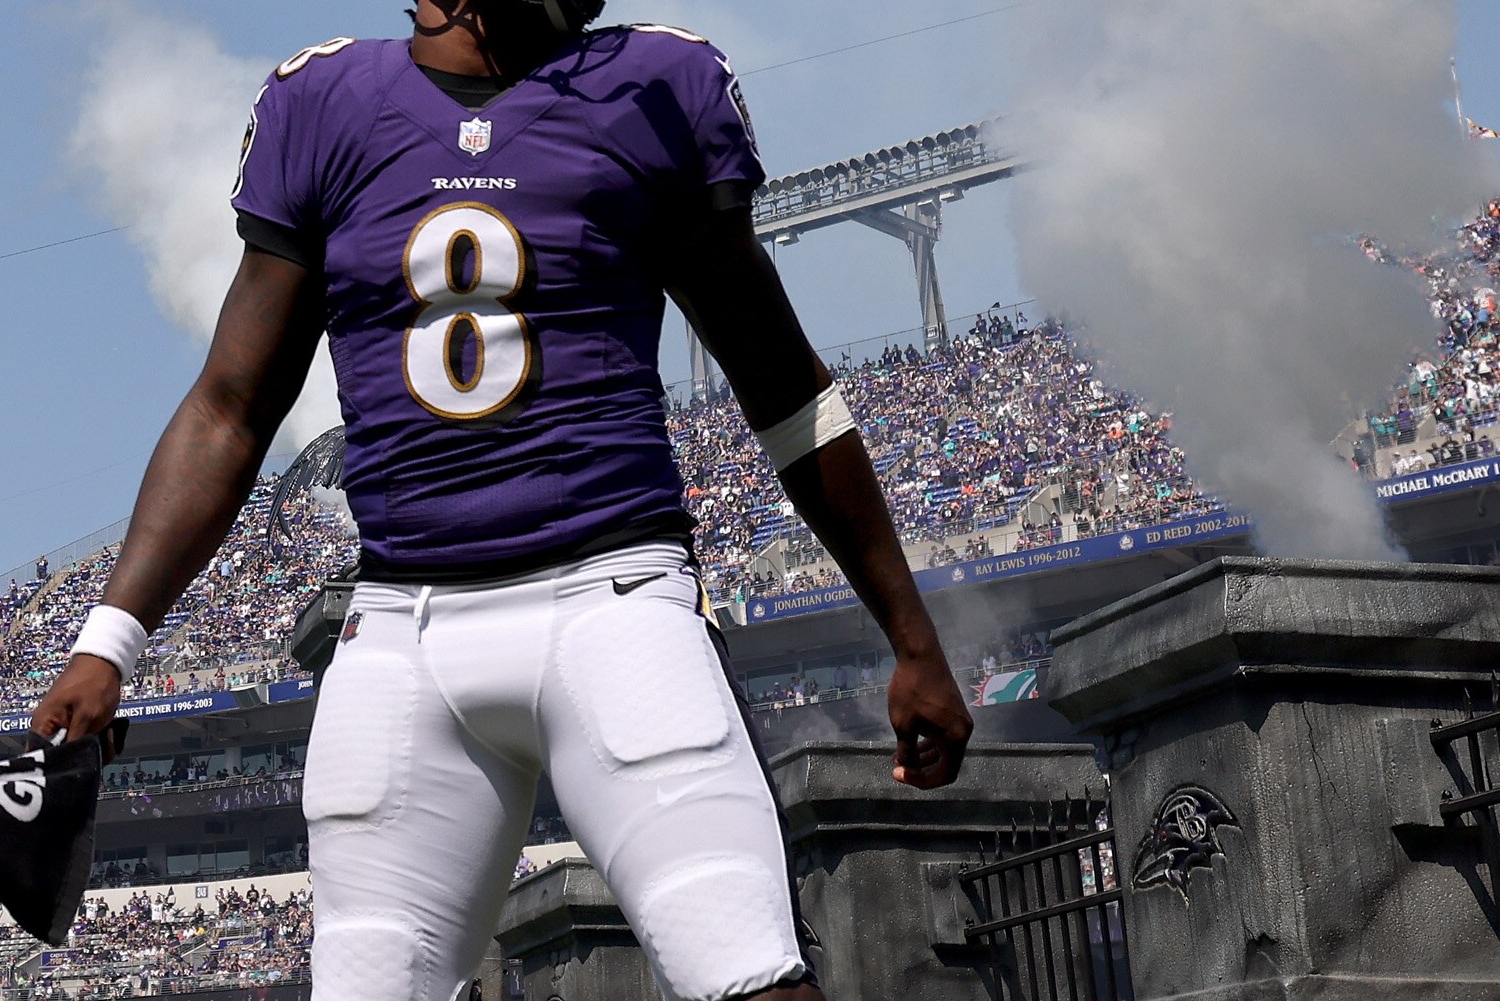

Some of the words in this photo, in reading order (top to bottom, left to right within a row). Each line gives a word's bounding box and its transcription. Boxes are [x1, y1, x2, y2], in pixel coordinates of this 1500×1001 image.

[465, 135, 485, 148] NFL
[431, 177, 517, 190] RAVENS
[402, 200, 533, 420] 8
[1376, 477, 1431, 498] MICHAEL
[1432, 465, 1490, 487] McCRARY
[1146, 531, 1161, 543] ED
[1164, 525, 1192, 540] REED
[975, 563, 994, 576] RAY
[997, 557, 1026, 572] LEWIS
[1028, 546, 1081, 566] 1996-2012
[773, 594, 822, 614] JONATHAN
[824, 588, 857, 603] OGDEN
[114, 707, 143, 718] ARNEST
[146, 704, 171, 715] BYNER
[174, 698, 213, 712] 1996-2003
